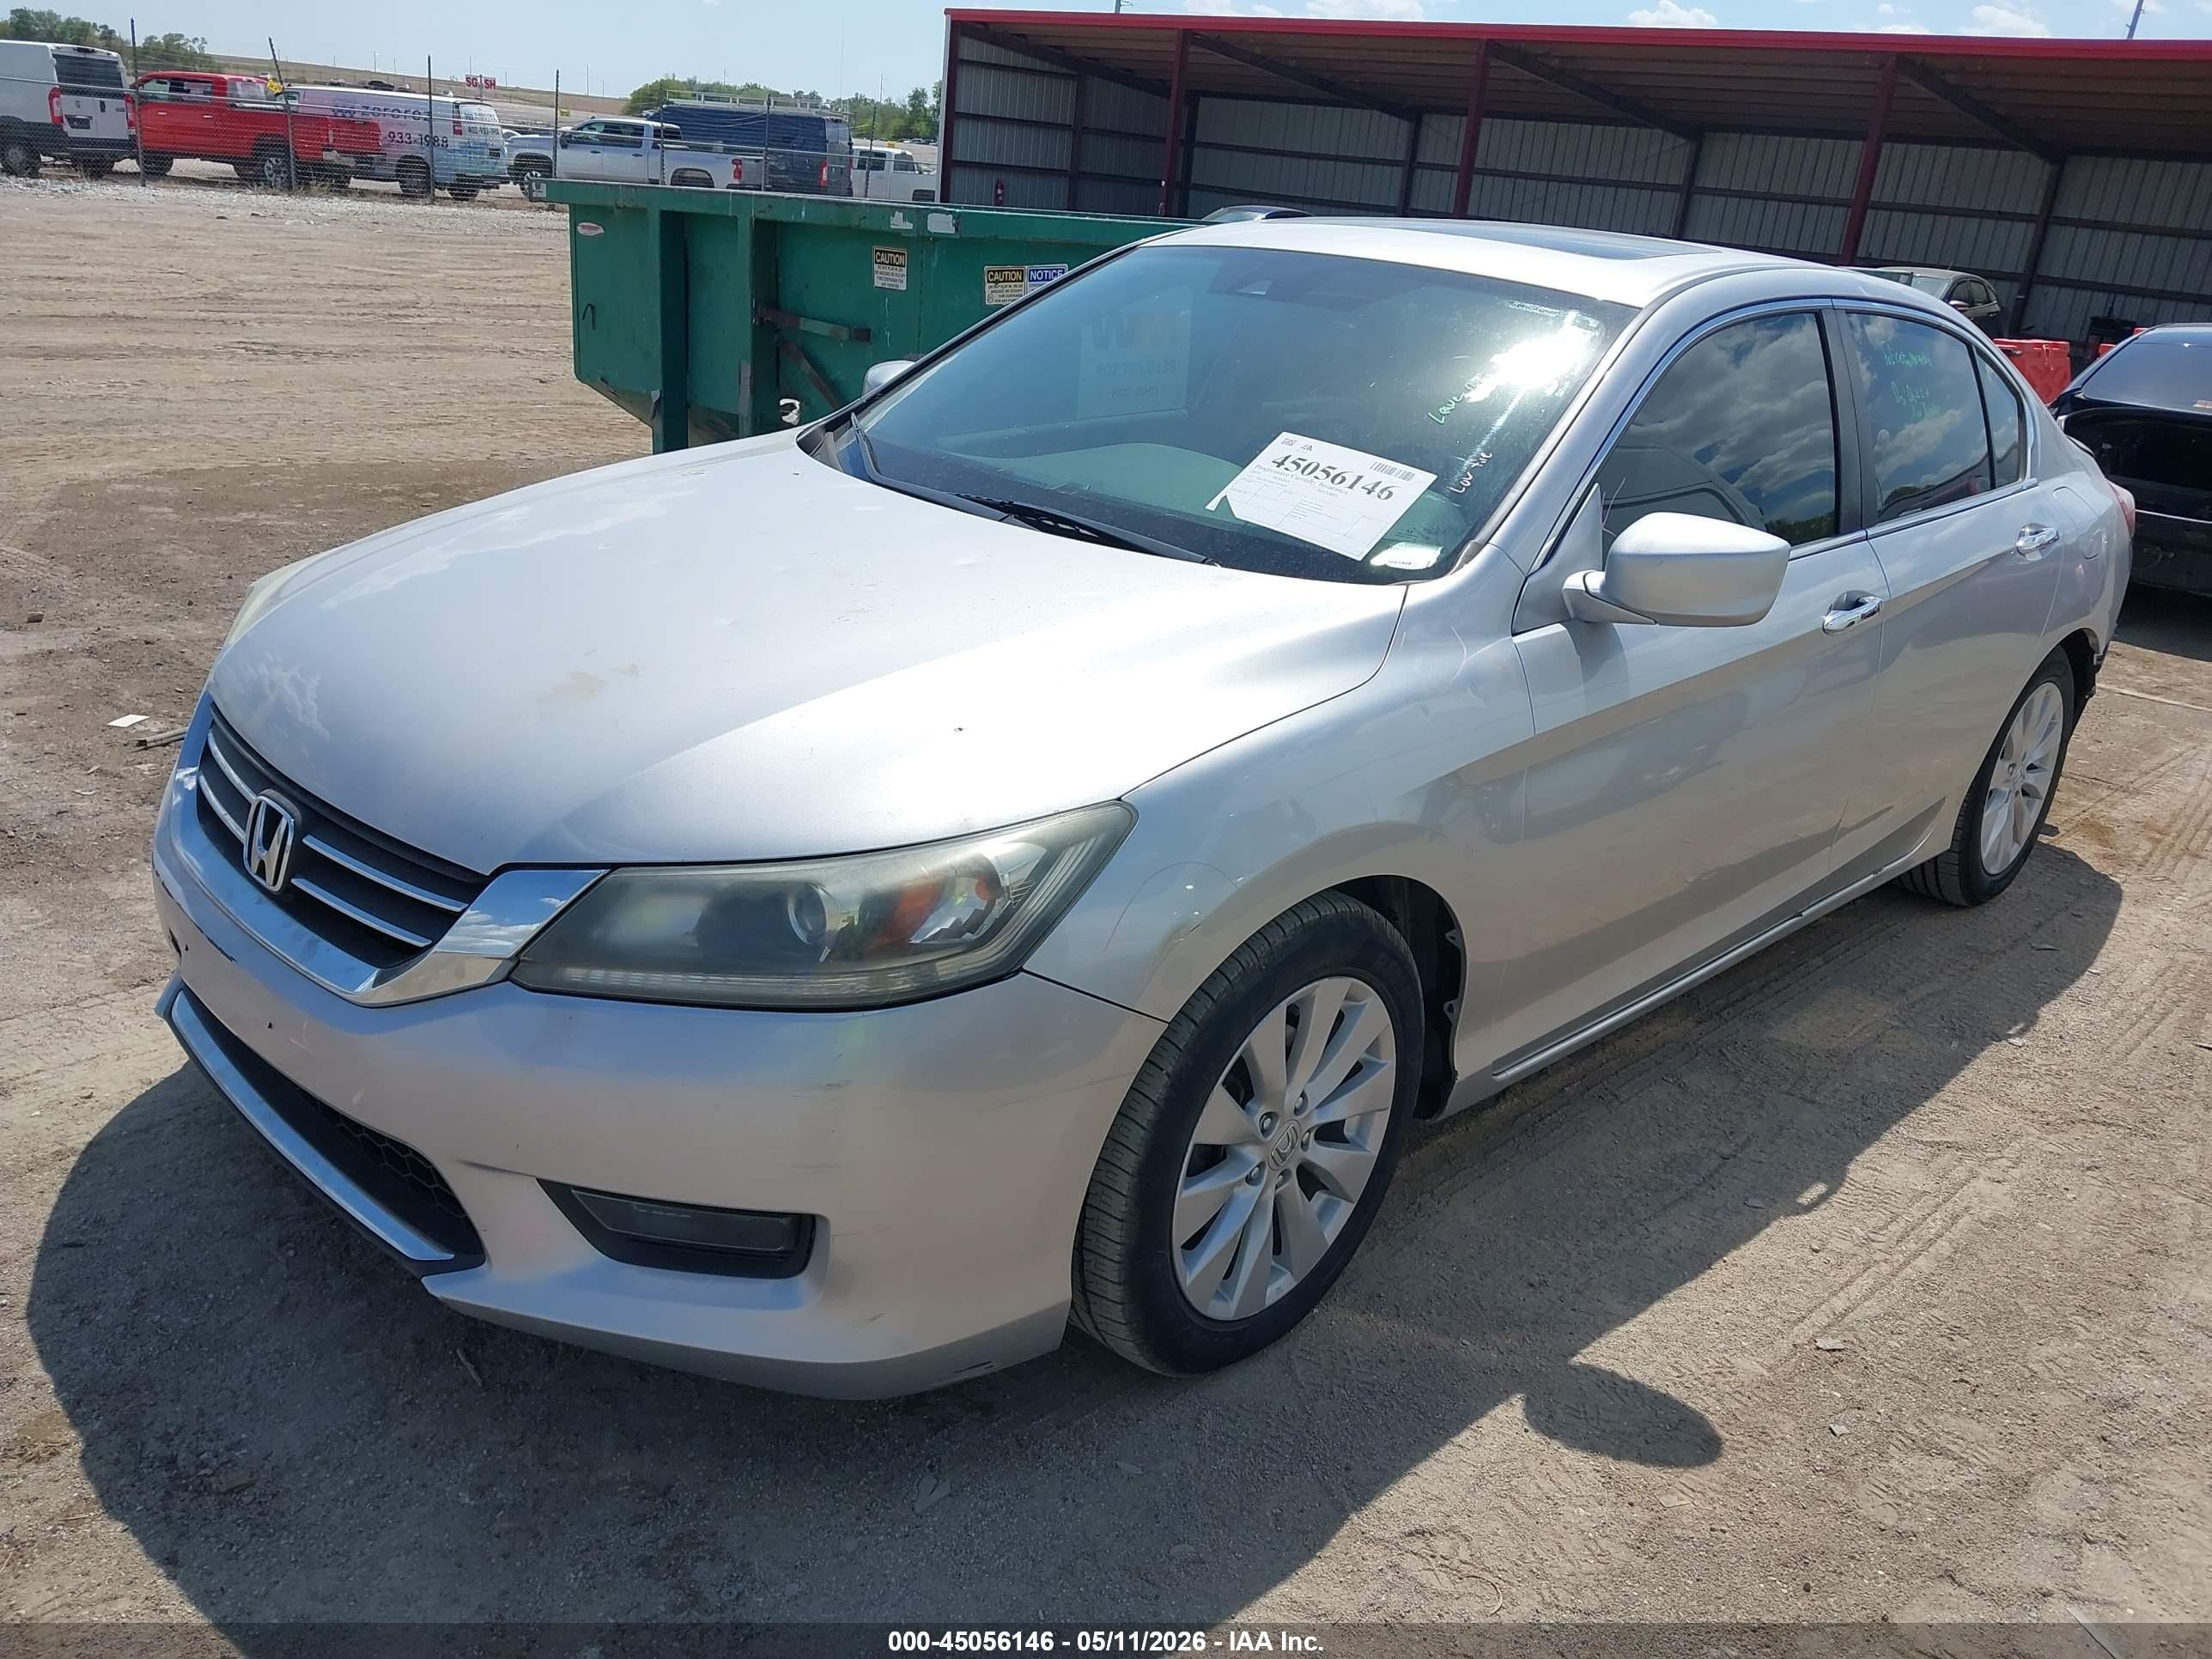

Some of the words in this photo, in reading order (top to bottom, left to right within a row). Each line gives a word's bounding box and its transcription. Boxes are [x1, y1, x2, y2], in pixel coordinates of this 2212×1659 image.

[875, 251, 905, 267] CAUTION
[988, 270, 1023, 282] CAUTION
[1030, 269, 1063, 281] NOTICE
[1272, 454, 1402, 501] 45056146
